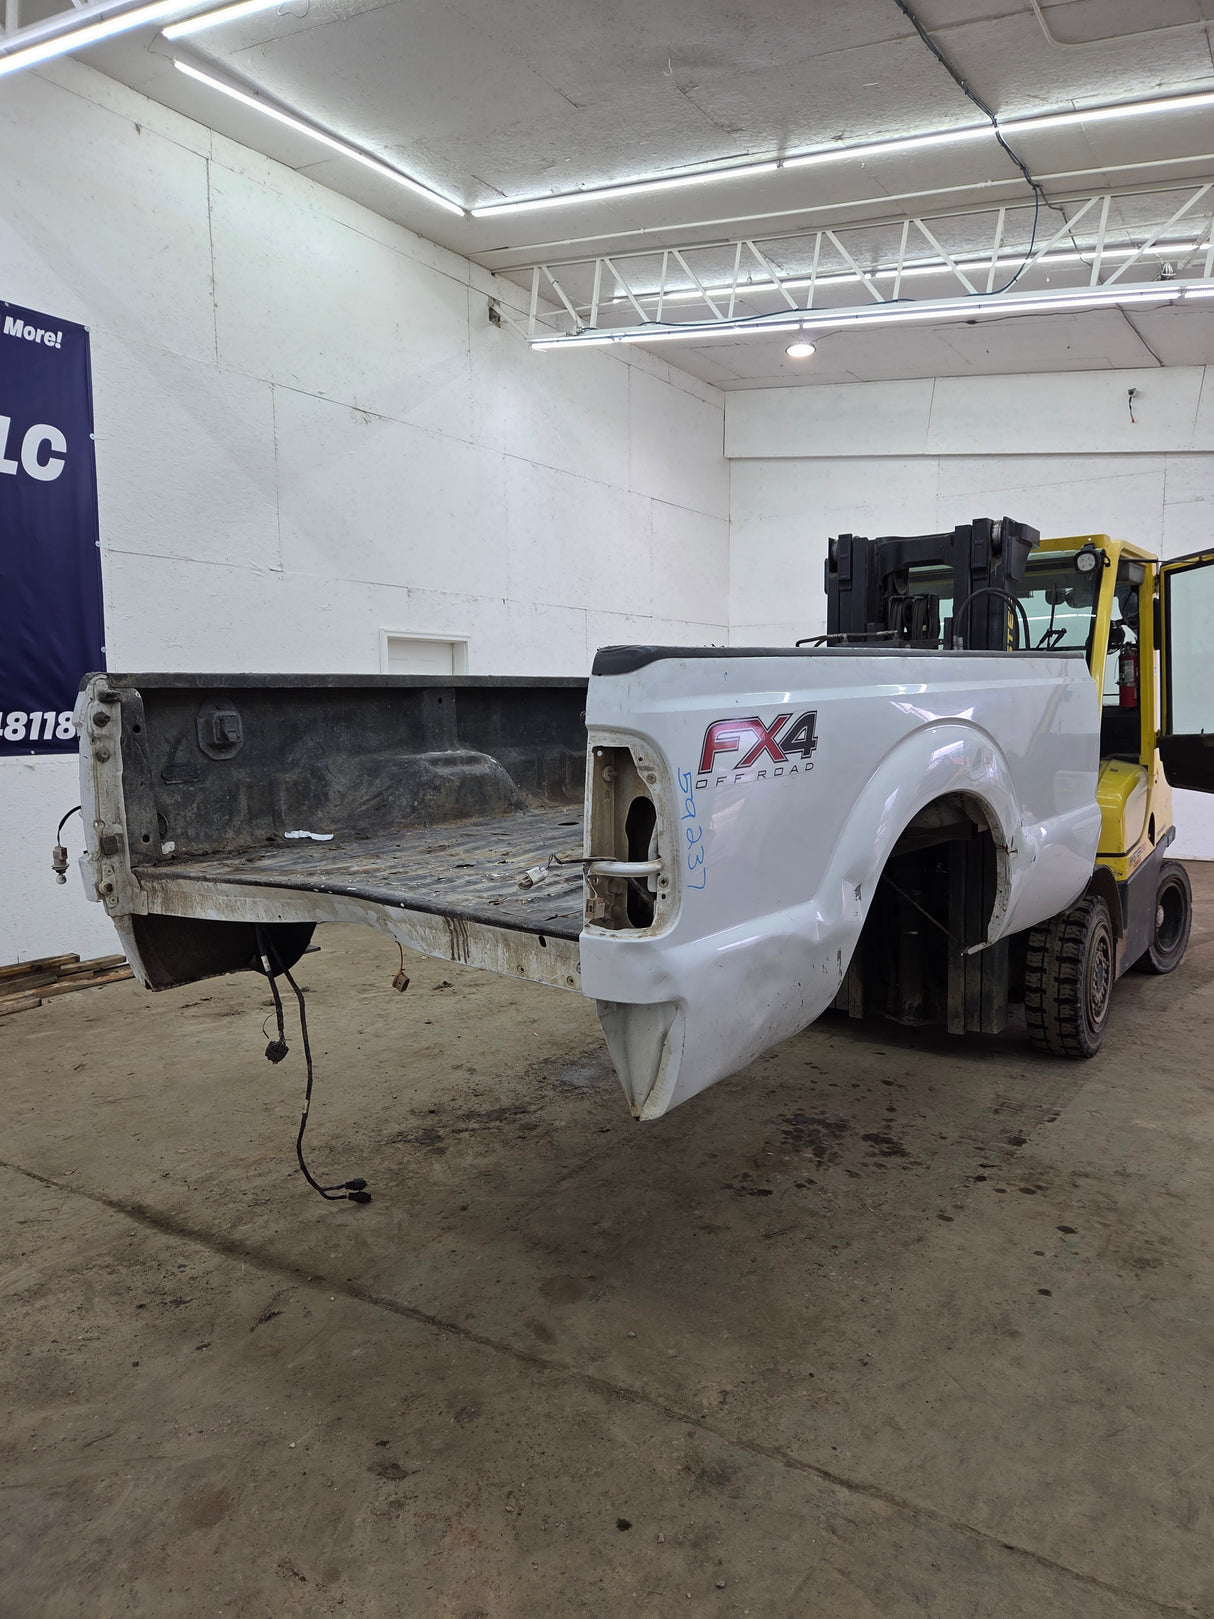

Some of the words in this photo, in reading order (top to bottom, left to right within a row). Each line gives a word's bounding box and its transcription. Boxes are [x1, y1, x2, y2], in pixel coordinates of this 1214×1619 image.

[4, 316, 63, 349] More!
[0, 711, 76, 741] 8118
[698, 710, 818, 775] FX4
[695, 773, 745, 789] OFF
[757, 763, 814, 780] ROAD
